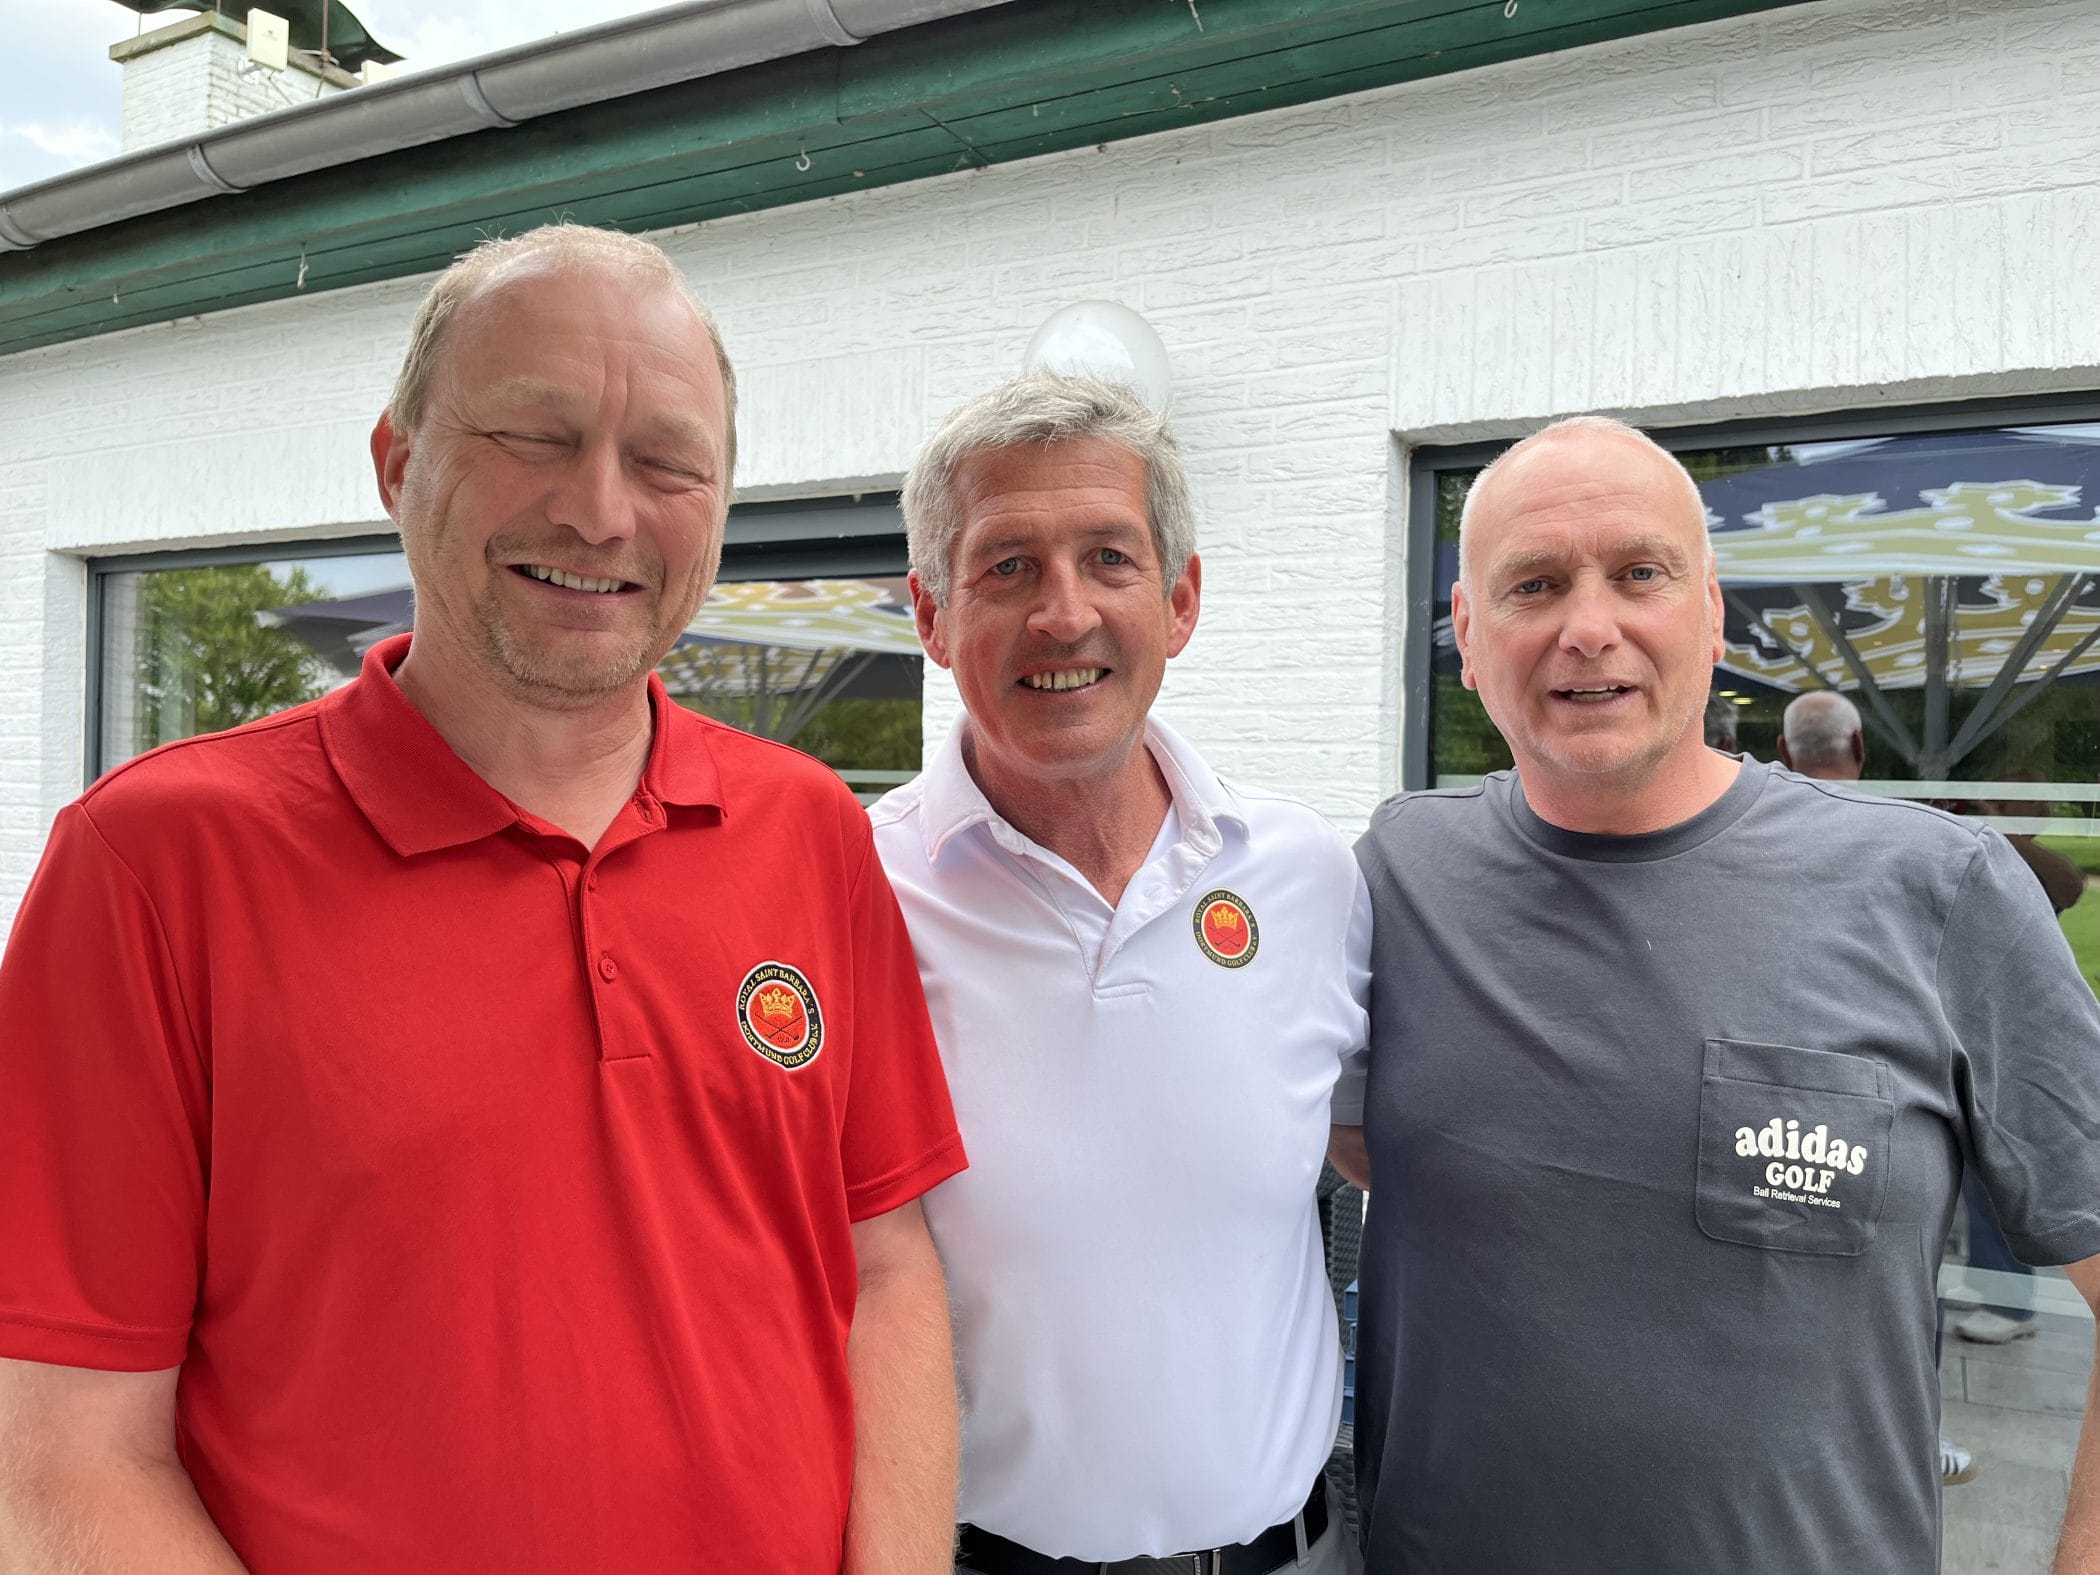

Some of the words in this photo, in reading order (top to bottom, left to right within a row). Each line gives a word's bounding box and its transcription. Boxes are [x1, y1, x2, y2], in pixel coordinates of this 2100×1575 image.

[1196, 931, 1226, 965] DORTMUND
[739, 979, 757, 1010] ROYAL
[755, 968, 779, 982] SAINT
[741, 1020, 783, 1063] DORTMUND
[1735, 1117, 1867, 1175] adidas
[1765, 1161, 1835, 1193] GOLF
[1753, 1186, 1769, 1198] Ball
[1771, 1189, 1806, 1203] Retrieval
[1807, 1194, 1841, 1208] Services
